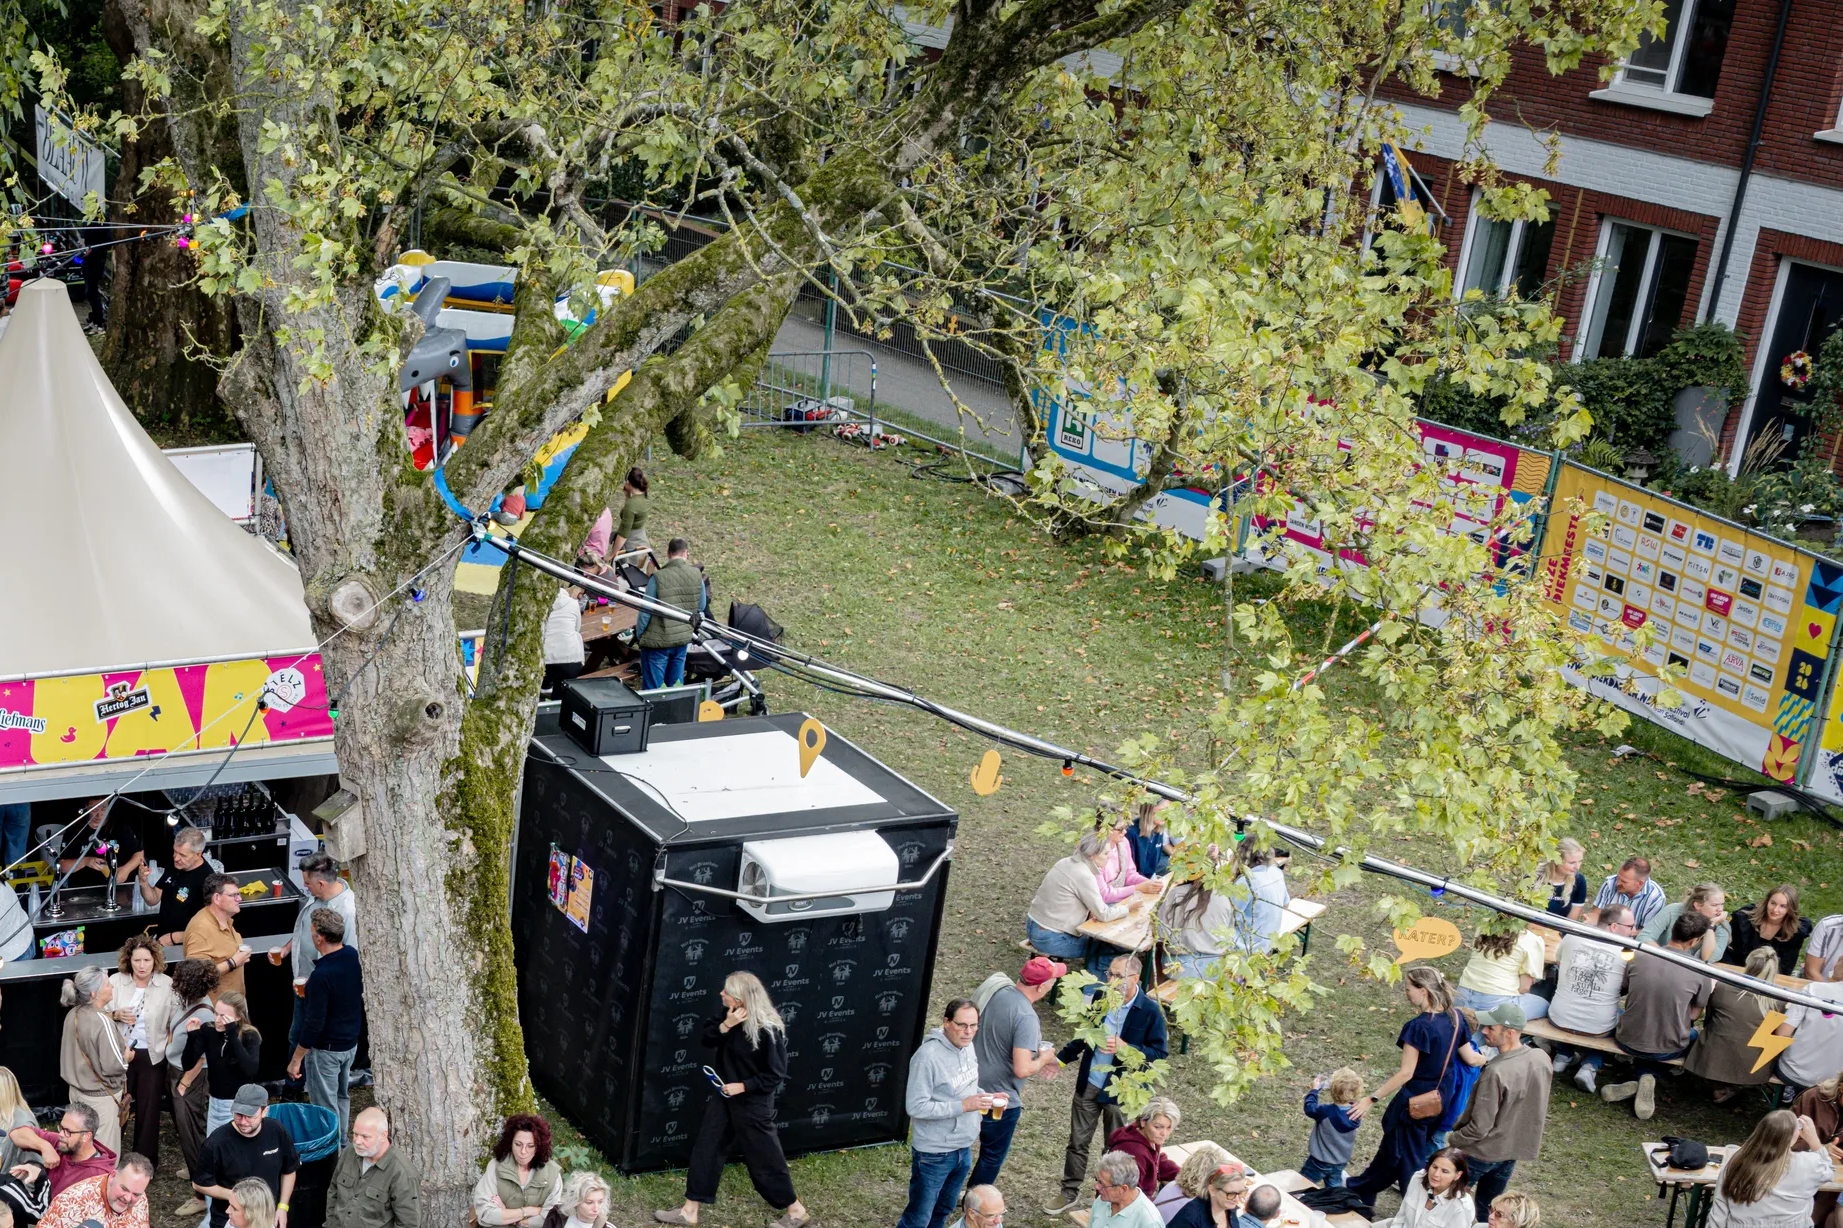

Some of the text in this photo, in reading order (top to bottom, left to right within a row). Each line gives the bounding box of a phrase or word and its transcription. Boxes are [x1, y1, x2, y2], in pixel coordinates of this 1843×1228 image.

[1736, 604, 1753, 615] Jester
[1724, 654, 1744, 671] ARVA
[1798, 661, 1812, 677] 20
[1795, 675, 1809, 691] 26
[1750, 690, 1767, 705] Smid
[100, 692, 148, 717] Hertog Jan
[31, 660, 271, 764] BAR
[1667, 704, 1691, 720] estival
[895, 892, 922, 902] Events
[828, 938, 838, 946] JV
[724, 945, 763, 956] JV Events
[873, 967, 912, 977] JV Events
[771, 977, 809, 988] JV Events
[668, 988, 707, 1000] JV Events
[817, 1008, 855, 1019] JV Events
[862, 1039, 900, 1049] JV Events
[660, 1062, 697, 1074] JV Events
[807, 1080, 844, 1091] JV Events
[851, 1110, 888, 1120] JV Events
[650, 1133, 688, 1144] JV Events
